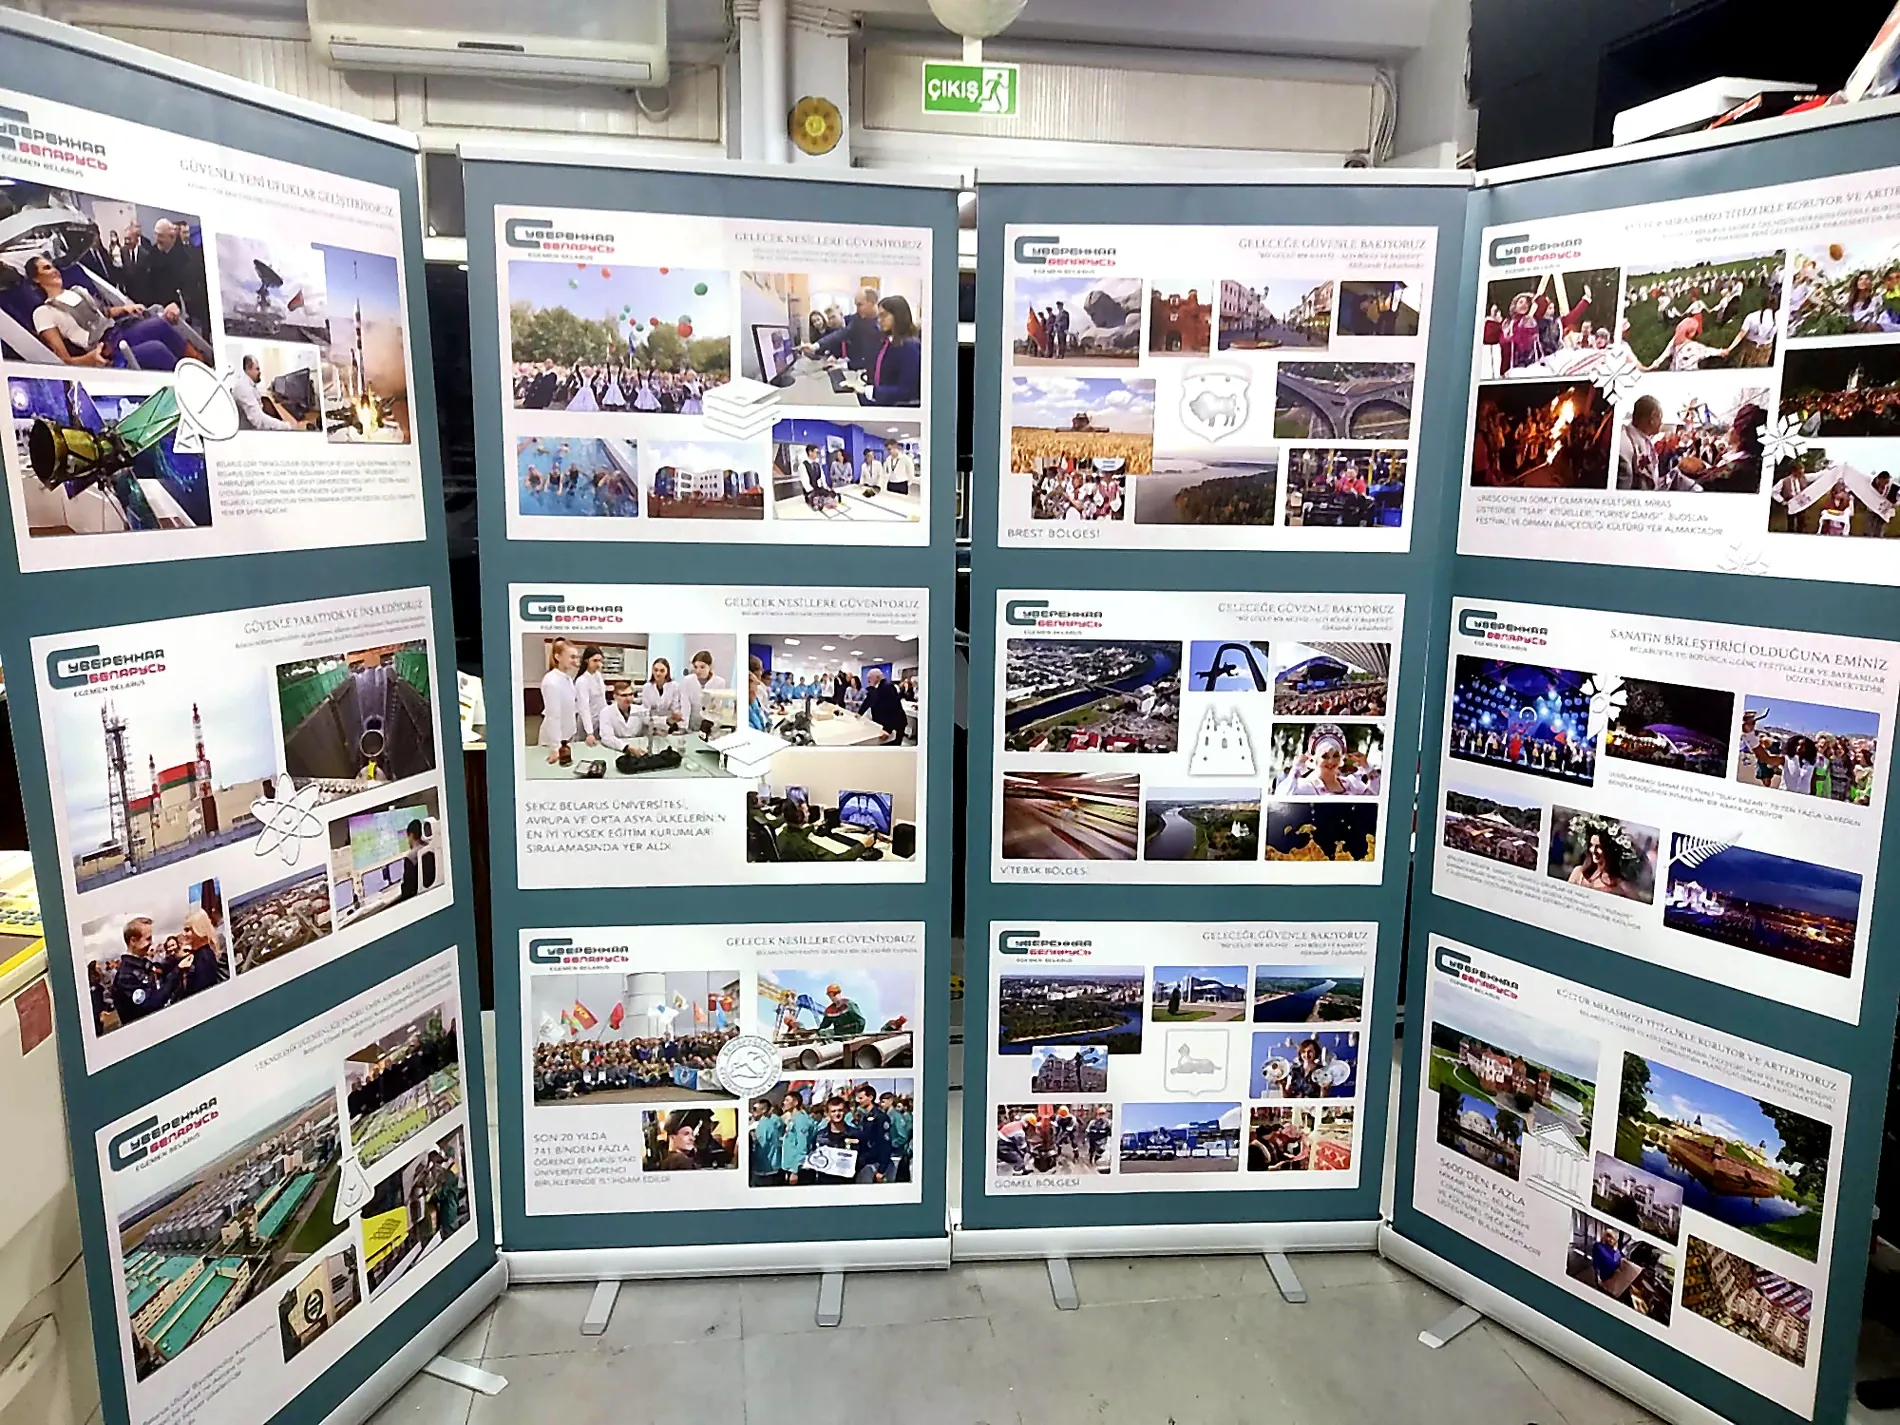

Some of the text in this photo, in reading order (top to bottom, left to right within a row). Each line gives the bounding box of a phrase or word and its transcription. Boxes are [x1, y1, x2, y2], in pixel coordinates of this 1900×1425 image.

[927, 79, 979, 103] ÇIKIŞ
[1007, 528, 1044, 539] BREST
[1749, 641, 1831, 665] OLDUĞUNA
[1833, 650, 1889, 673] EMİNİZ
[90, 663, 167, 684] БЕЛАРУСЬ
[559, 800, 609, 812] BELARUS
[525, 815, 570, 826] AVRUPA
[572, 815, 587, 825] VE
[590, 814, 621, 825] ORTA
[624, 814, 653, 825] ASYA
[526, 829, 542, 840] EN
[562, 827, 605, 840] YÜKSEK
[608, 826, 647, 839] EĞİTİM
[526, 843, 620, 854] SIRALAMASINDA
[622, 842, 643, 852] YER
[1000, 865, 1041, 875] VTEBSK
[150, 1110, 219, 1153] БЕЛАРУСЬ
[533, 1132, 558, 1143] SON
[560, 1132, 574, 1142] 20
[598, 1143, 630, 1154] FAZLA
[994, 1178, 1032, 1190] GOMEL
[1491, 1182, 1526, 1207] FAZLA
